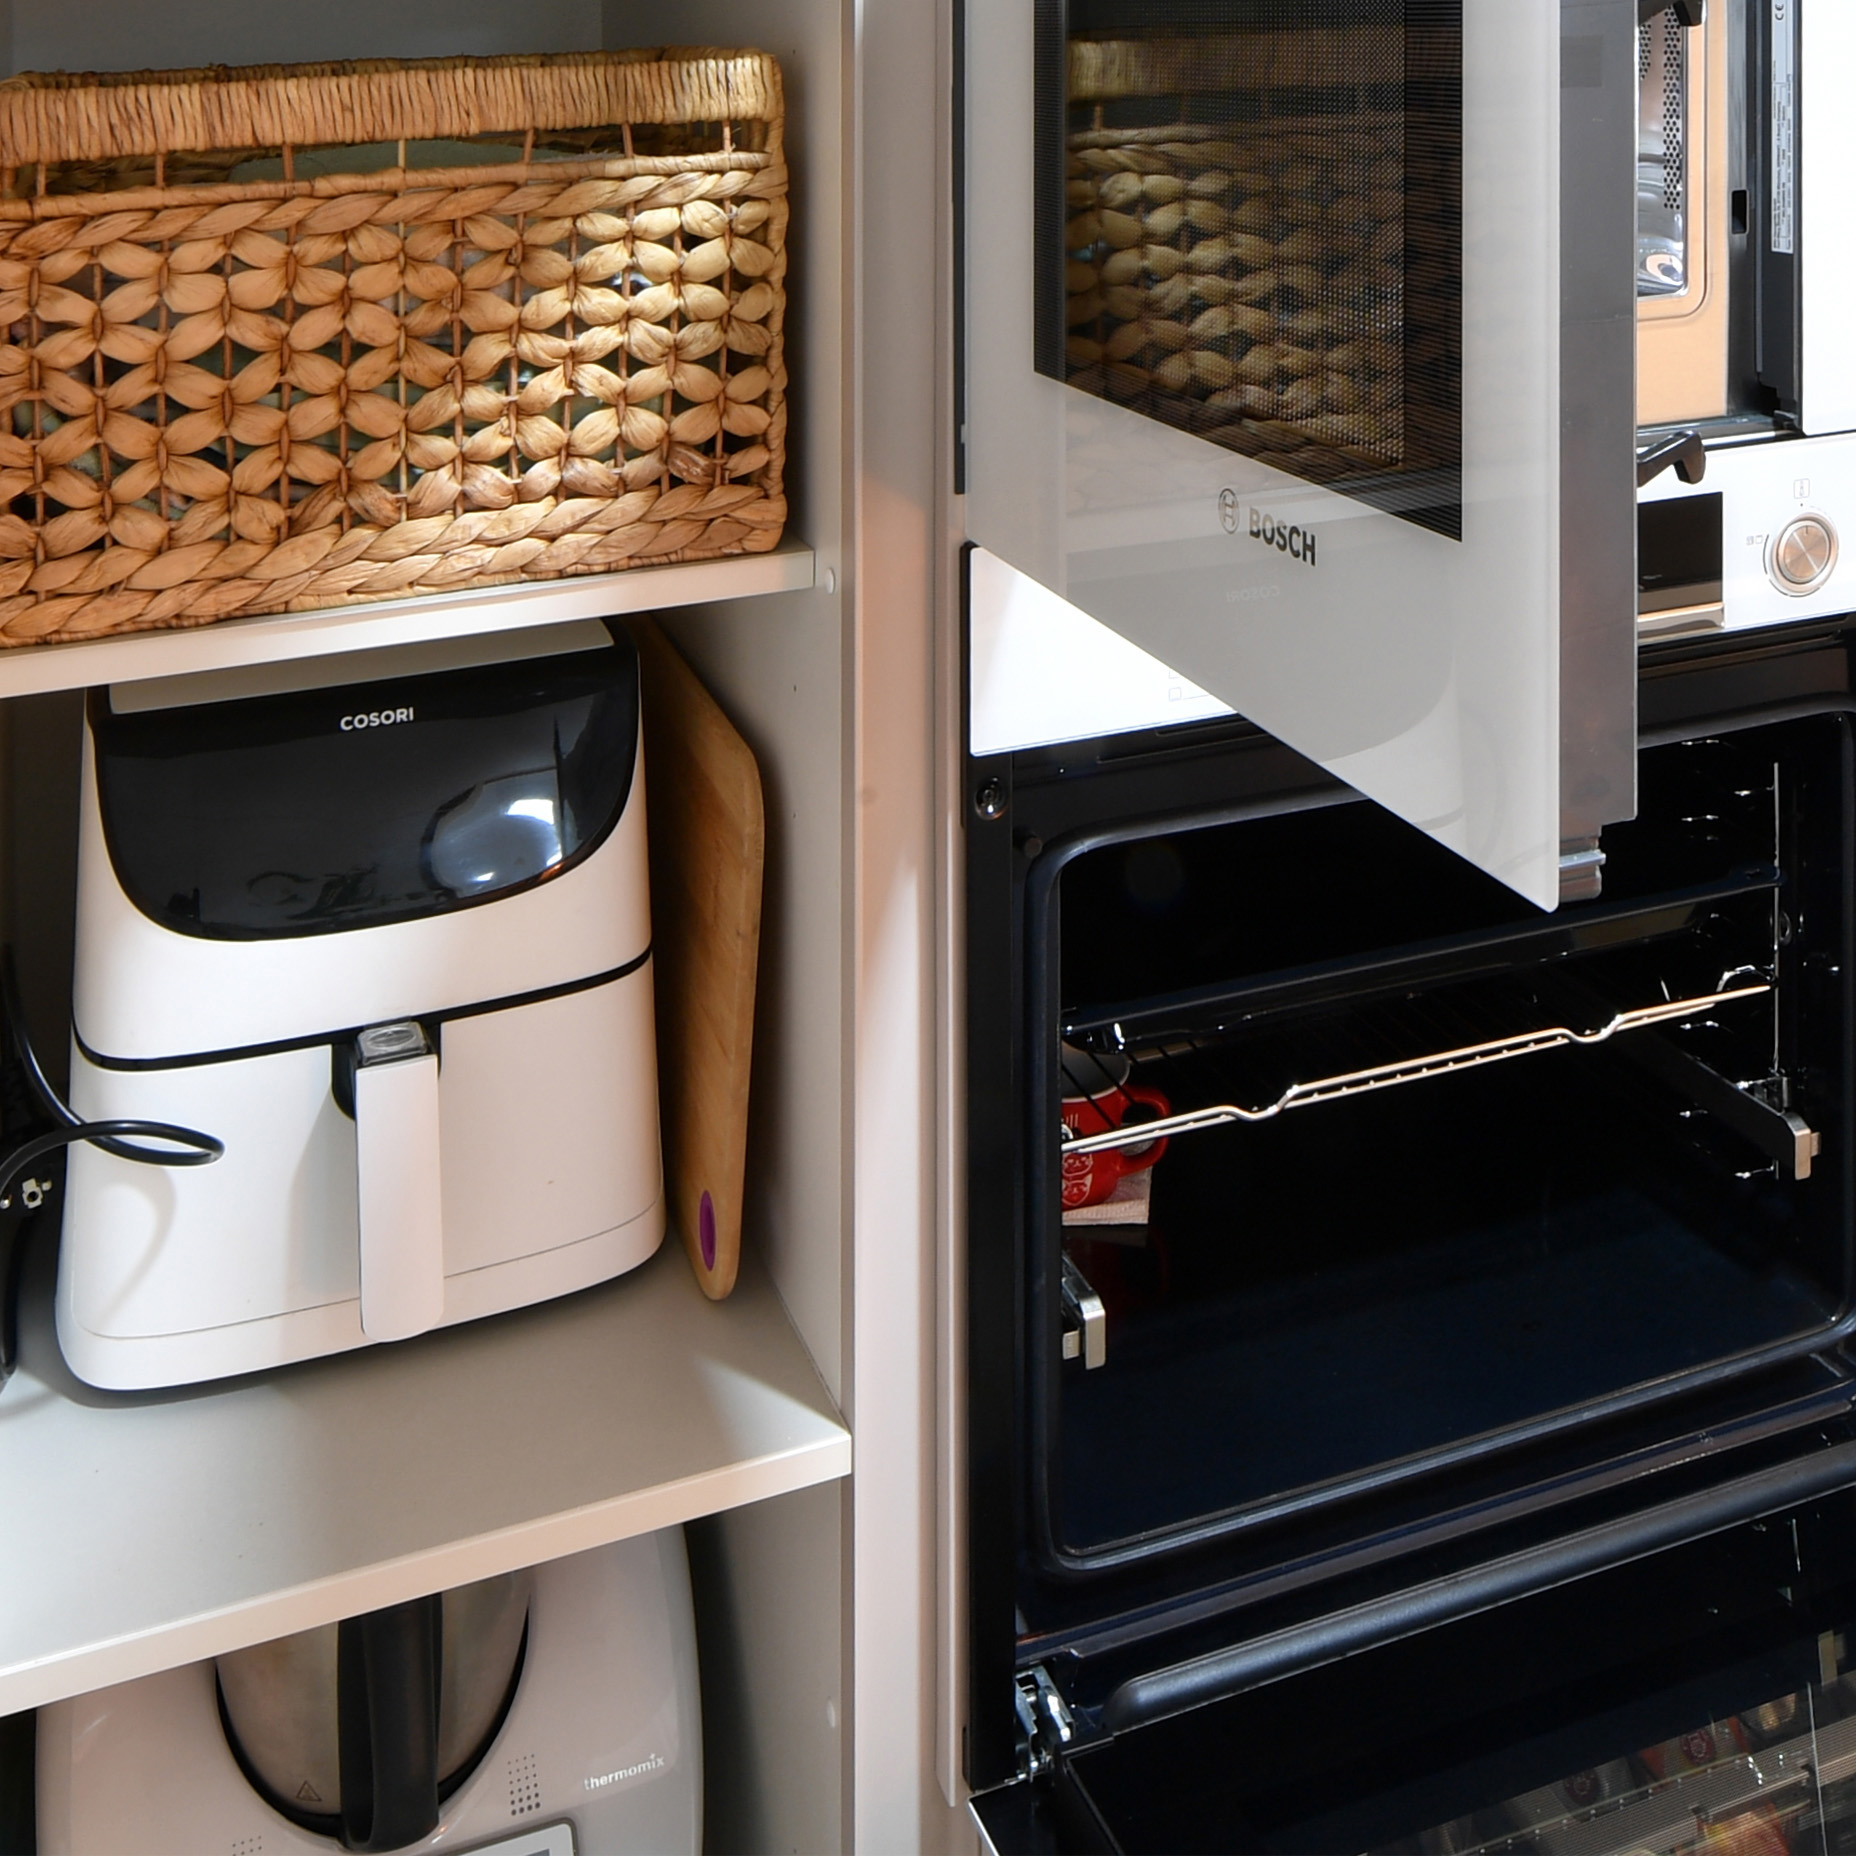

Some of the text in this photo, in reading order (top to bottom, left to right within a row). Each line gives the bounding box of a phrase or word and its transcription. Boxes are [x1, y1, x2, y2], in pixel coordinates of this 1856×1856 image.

[1249, 506, 1317, 568] BOSCH
[339, 706, 415, 732] COSORI
[584, 1752, 665, 1791] thermomix
